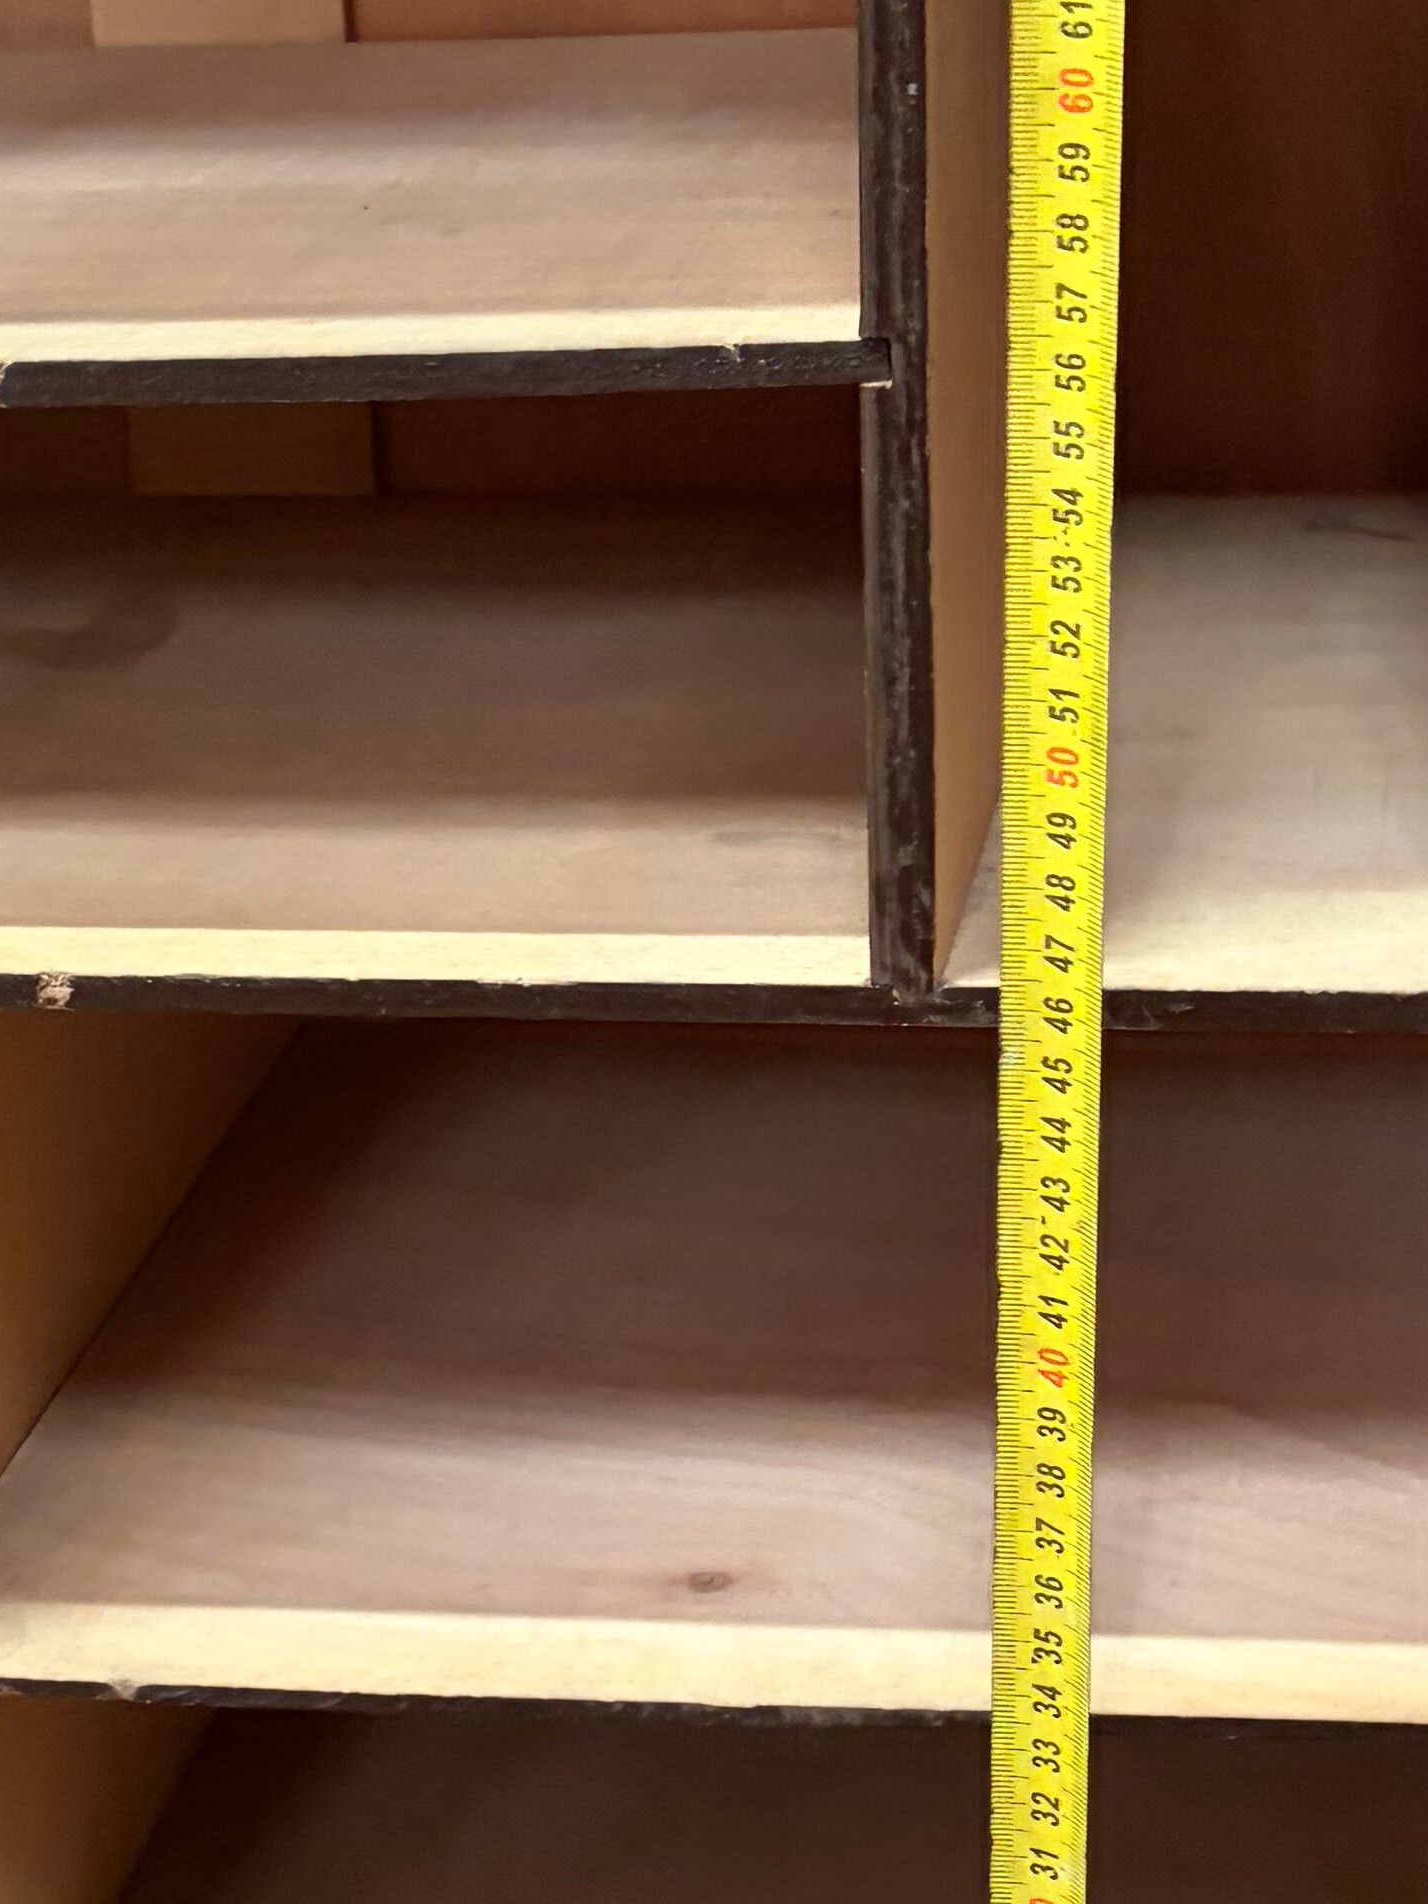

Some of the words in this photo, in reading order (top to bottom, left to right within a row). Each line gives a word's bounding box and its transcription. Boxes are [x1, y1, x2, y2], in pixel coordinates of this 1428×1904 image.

[1060, 2, 1092, 39] 61
[1058, 68, 1093, 113] 60
[1058, 143, 1090, 182] 59
[1056, 214, 1089, 253] 58
[1055, 283, 1087, 323] 57
[1055, 354, 1085, 392] 56
[1053, 421, 1084, 459] 55
[1052, 489, 1083, 526] 54
[1051, 555, 1082, 593] 53
[1050, 620, 1080, 658] 52
[1049, 689, 1079, 723] 51
[1046, 747, 1079, 788] 50
[1046, 813, 1076, 849] 49
[1045, 874, 1076, 911] 48
[1044, 935, 1074, 973] 47
[1043, 997, 1073, 1034] 46
[1041, 1056, 1072, 1094] 45
[1040, 1117, 1071, 1153] 44
[1040, 1176, 1070, 1212] 43
[1039, 1234, 1069, 1270] 42
[1038, 1295, 1068, 1329] 41
[1037, 1348, 1070, 1388] 40
[1037, 1407, 1066, 1442] 39
[1036, 1463, 1065, 1498] 38
[1035, 1517, 1064, 1554] 37
[1034, 1575, 1063, 1609] 36
[1031, 1628, 1062, 1664] 35
[1032, 1684, 1062, 1718] 34
[1032, 1739, 1060, 1773] 33
[1030, 1792, 1059, 1826] 32
[1030, 1848, 1058, 1880] 31
